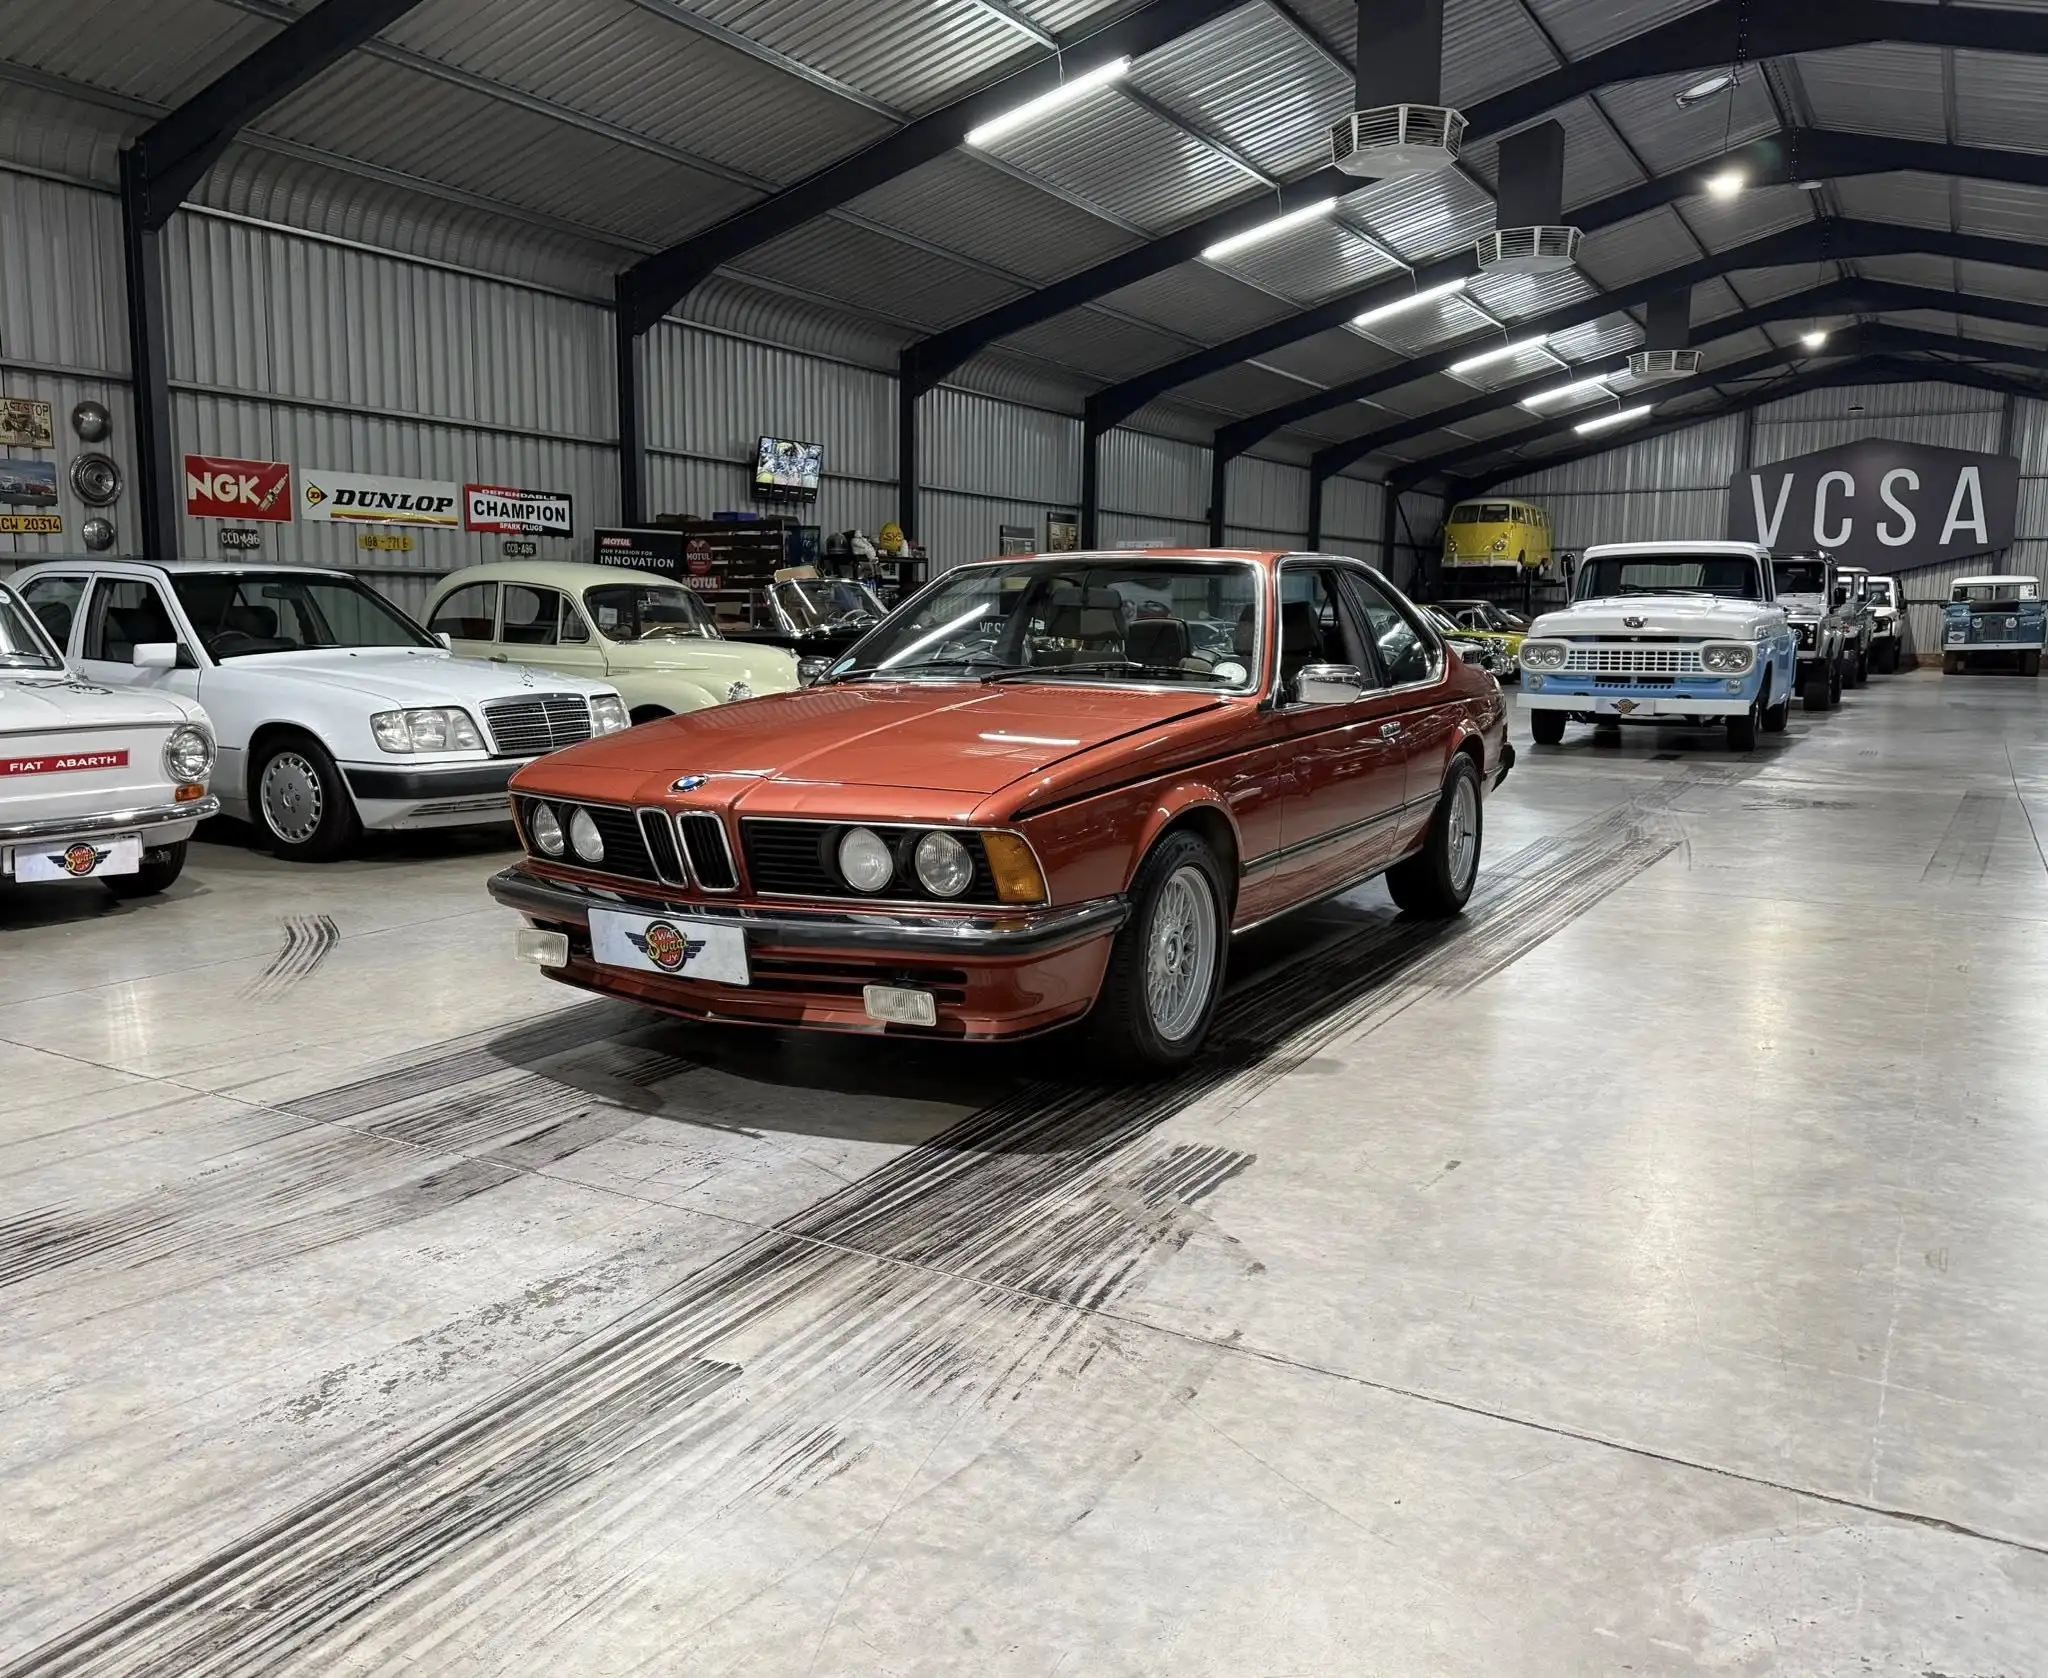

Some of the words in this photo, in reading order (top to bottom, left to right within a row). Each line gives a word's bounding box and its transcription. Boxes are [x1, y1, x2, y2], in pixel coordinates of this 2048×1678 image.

[0, 401, 21, 412] AST
[24, 402, 49, 417] STOP
[187, 471, 261, 506] NGK
[481, 489, 557, 501] DEPENDABLE
[332, 488, 454, 513] DUNLOP
[1750, 466, 1988, 548] VCSA
[473, 499, 566, 523] CHAMPION
[1, 517, 18, 531] CW
[23, 518, 60, 531] 20314
[500, 522, 520, 531] SPARK
[522, 523, 543, 532] PLUGS
[602, 537, 632, 547] MOTUL
[600, 554, 675, 569] INNOVATION
[687, 552, 711, 561] MOTUL
[682, 576, 719, 589] MOTUL
[9, 761, 44, 772] FIAT
[55, 755, 117, 769] ABARTH
[666, 954, 678, 962] JY
